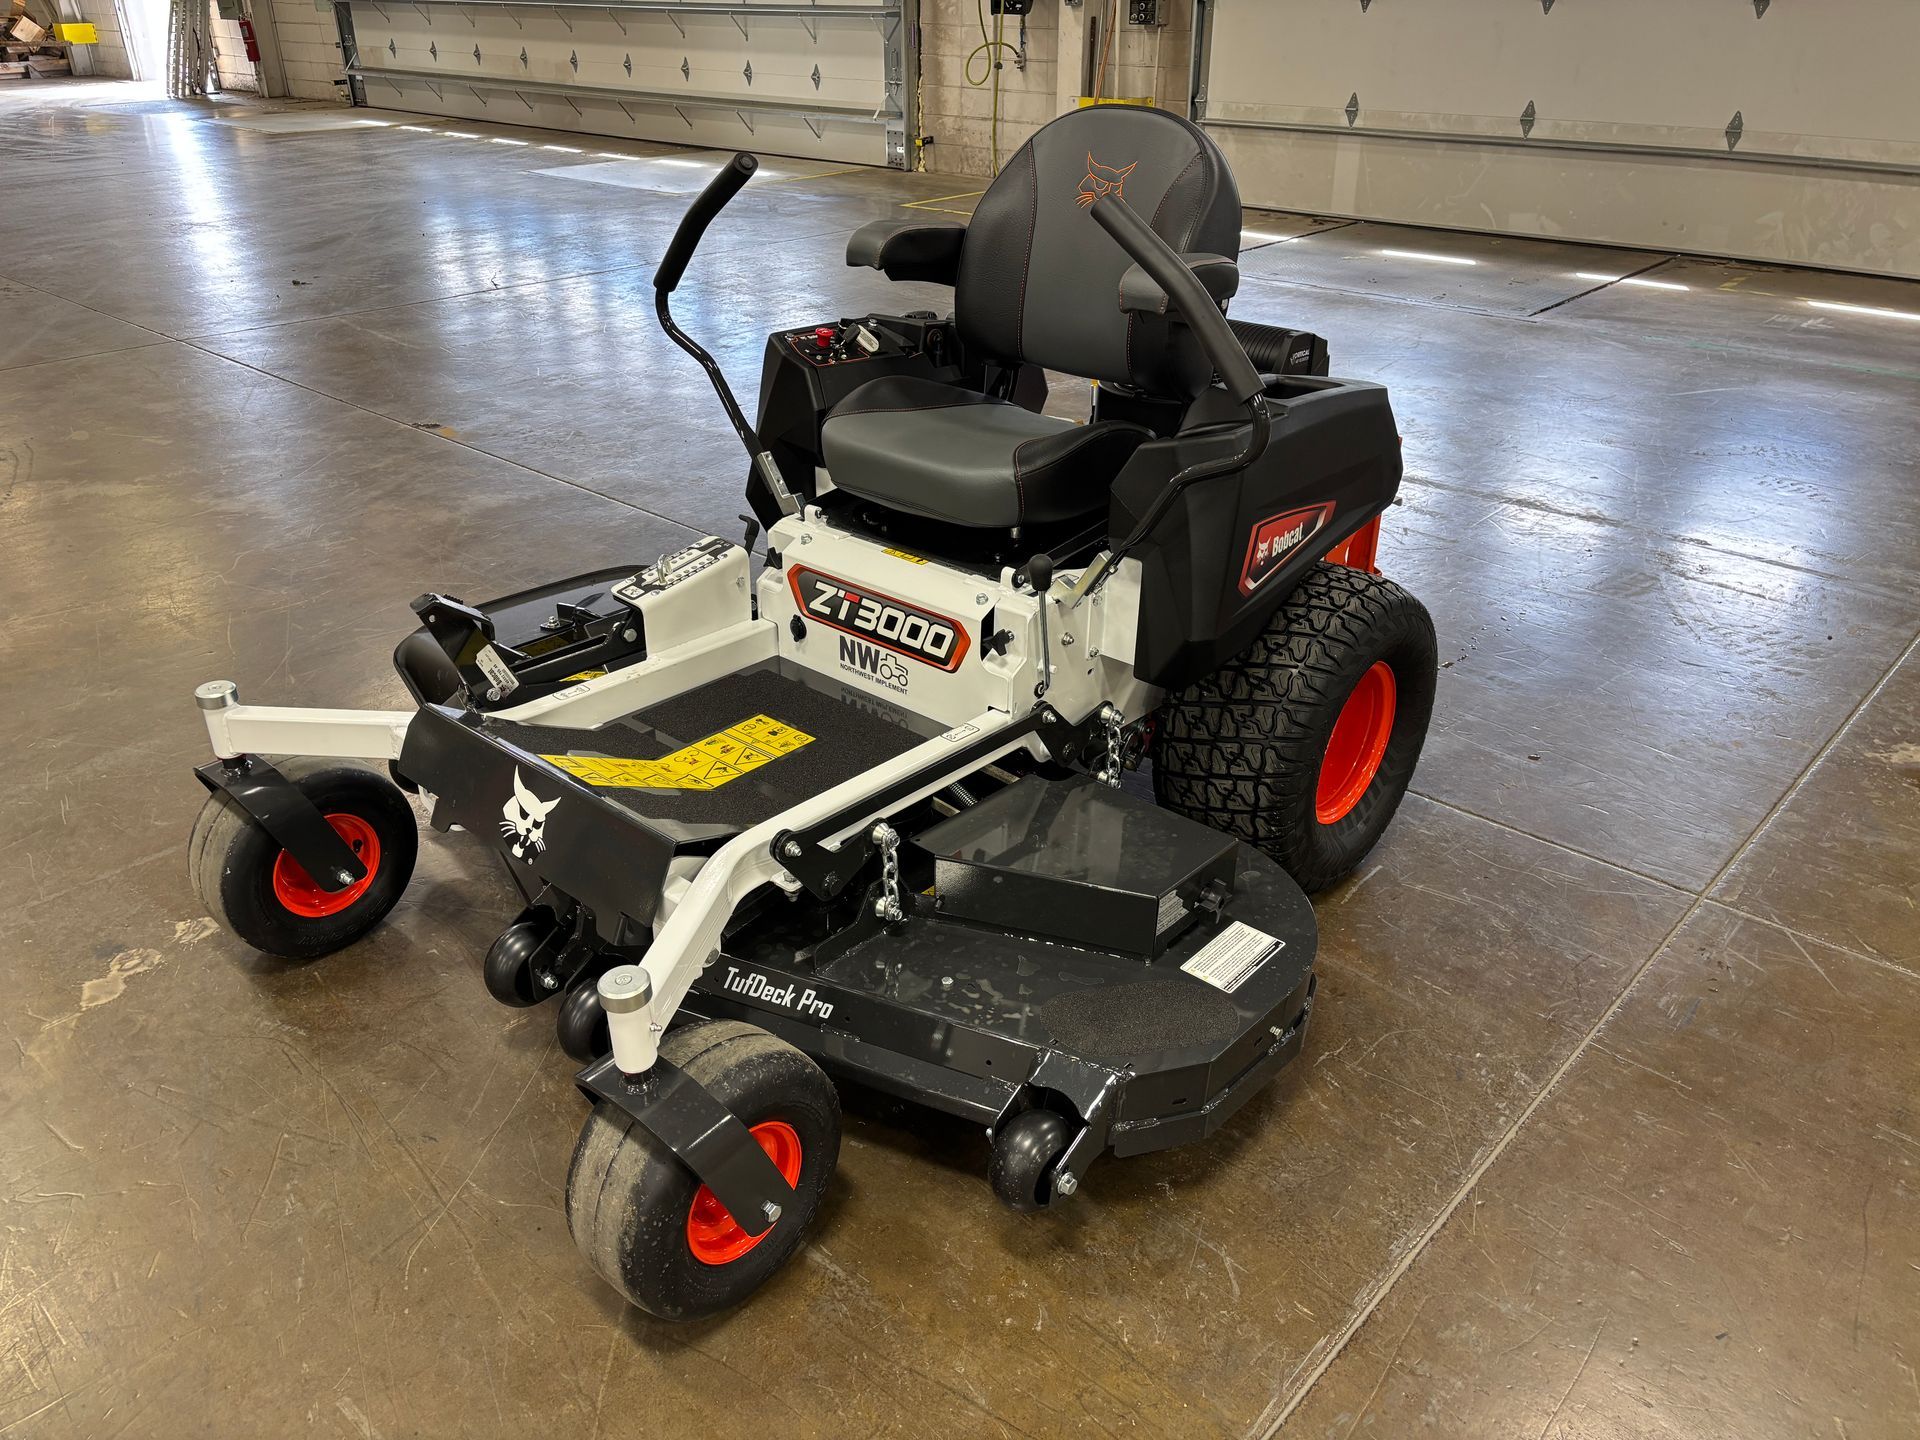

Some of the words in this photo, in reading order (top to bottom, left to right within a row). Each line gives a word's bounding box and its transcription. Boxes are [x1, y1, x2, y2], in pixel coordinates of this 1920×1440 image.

[1272, 521, 1304, 558] Bobcat
[839, 634, 880, 675] NW
[840, 663, 874, 682] NORTHWEST
[875, 677, 908, 695] IMPLEMENT
[723, 966, 796, 1008] TufDeck
[796, 988, 834, 1019] Pro
